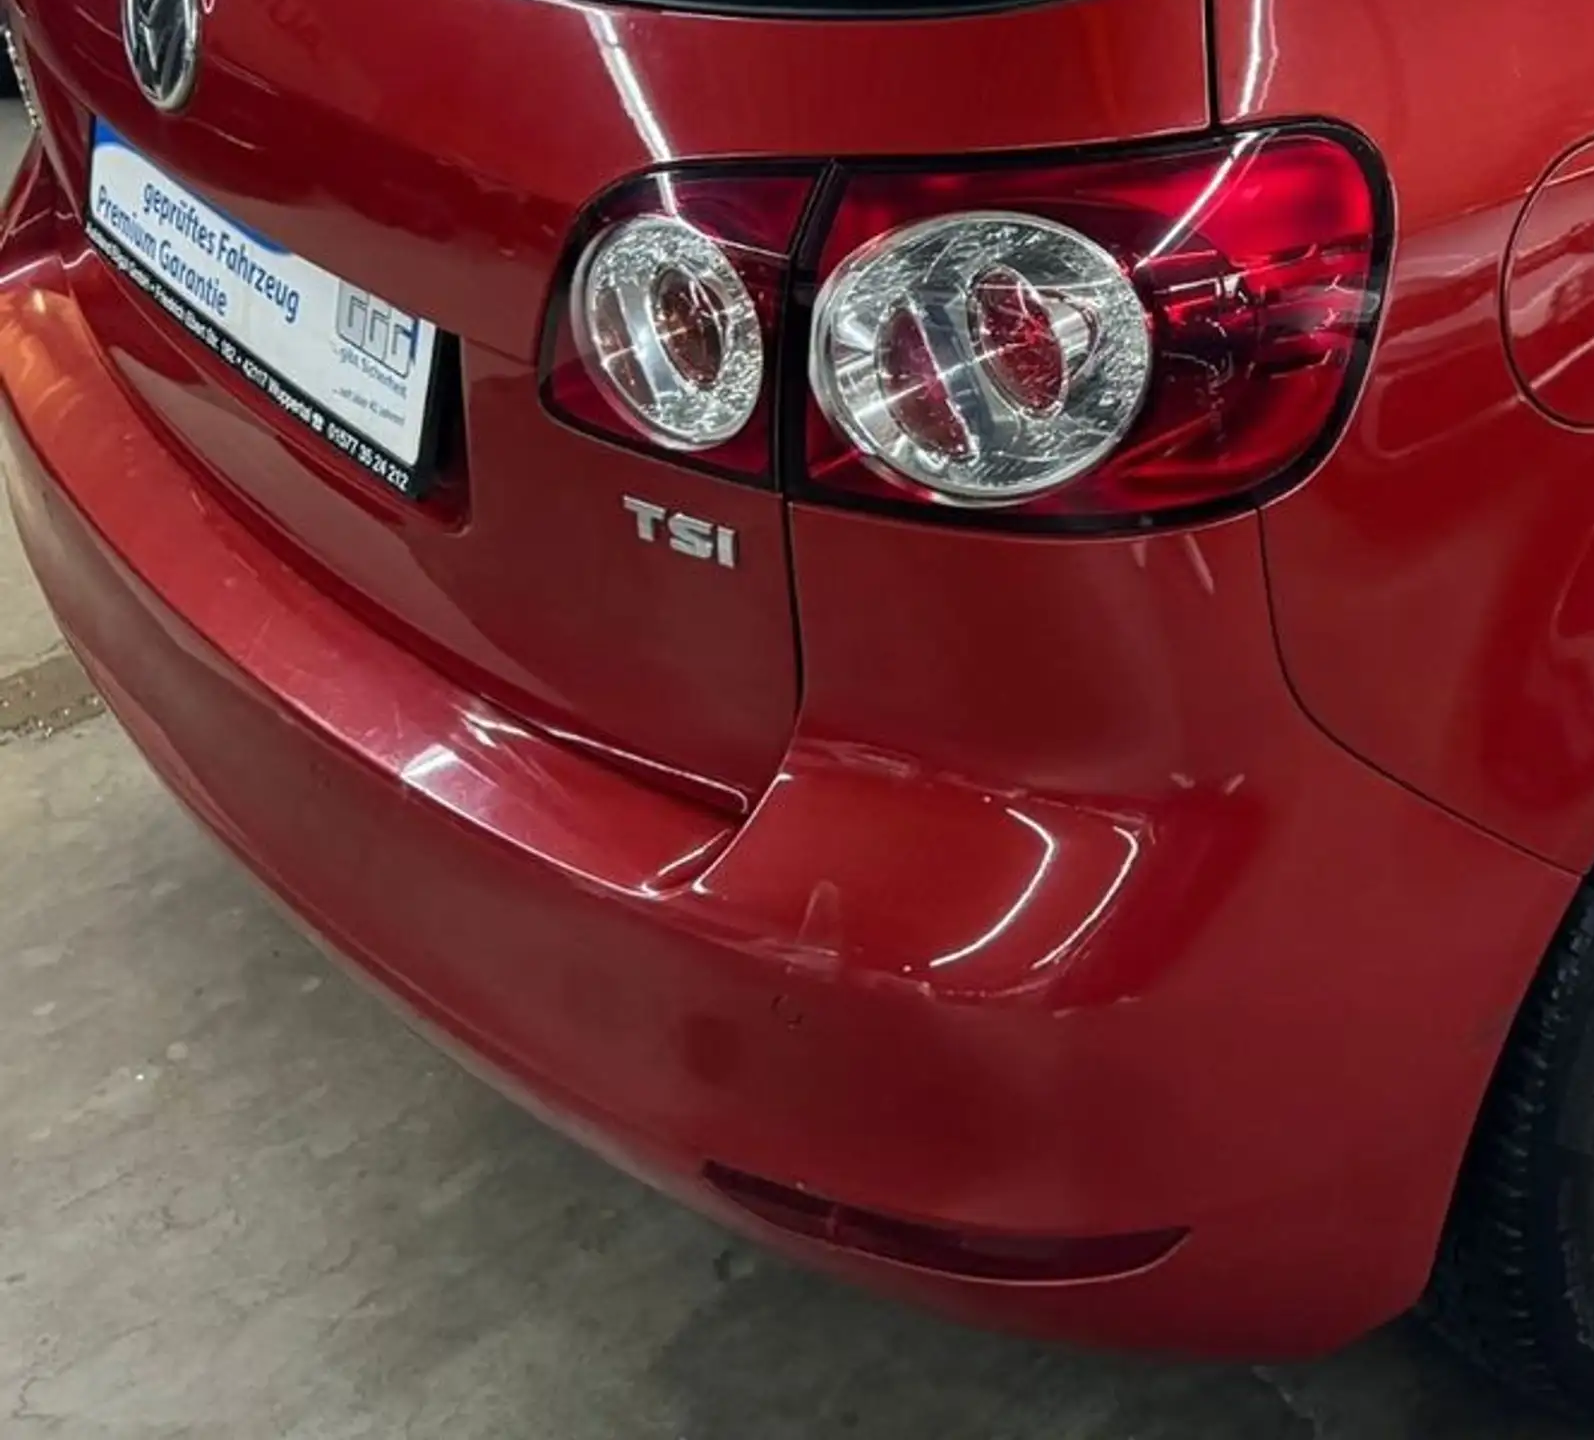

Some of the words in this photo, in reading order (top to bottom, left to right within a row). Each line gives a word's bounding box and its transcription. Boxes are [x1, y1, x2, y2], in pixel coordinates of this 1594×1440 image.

[97, 184, 158, 261] Premium
[158, 239, 228, 318] Garantie
[143, 182, 217, 257] geprüftes
[217, 231, 300, 324] Fahrzeug
[623, 494, 736, 570] TSI
